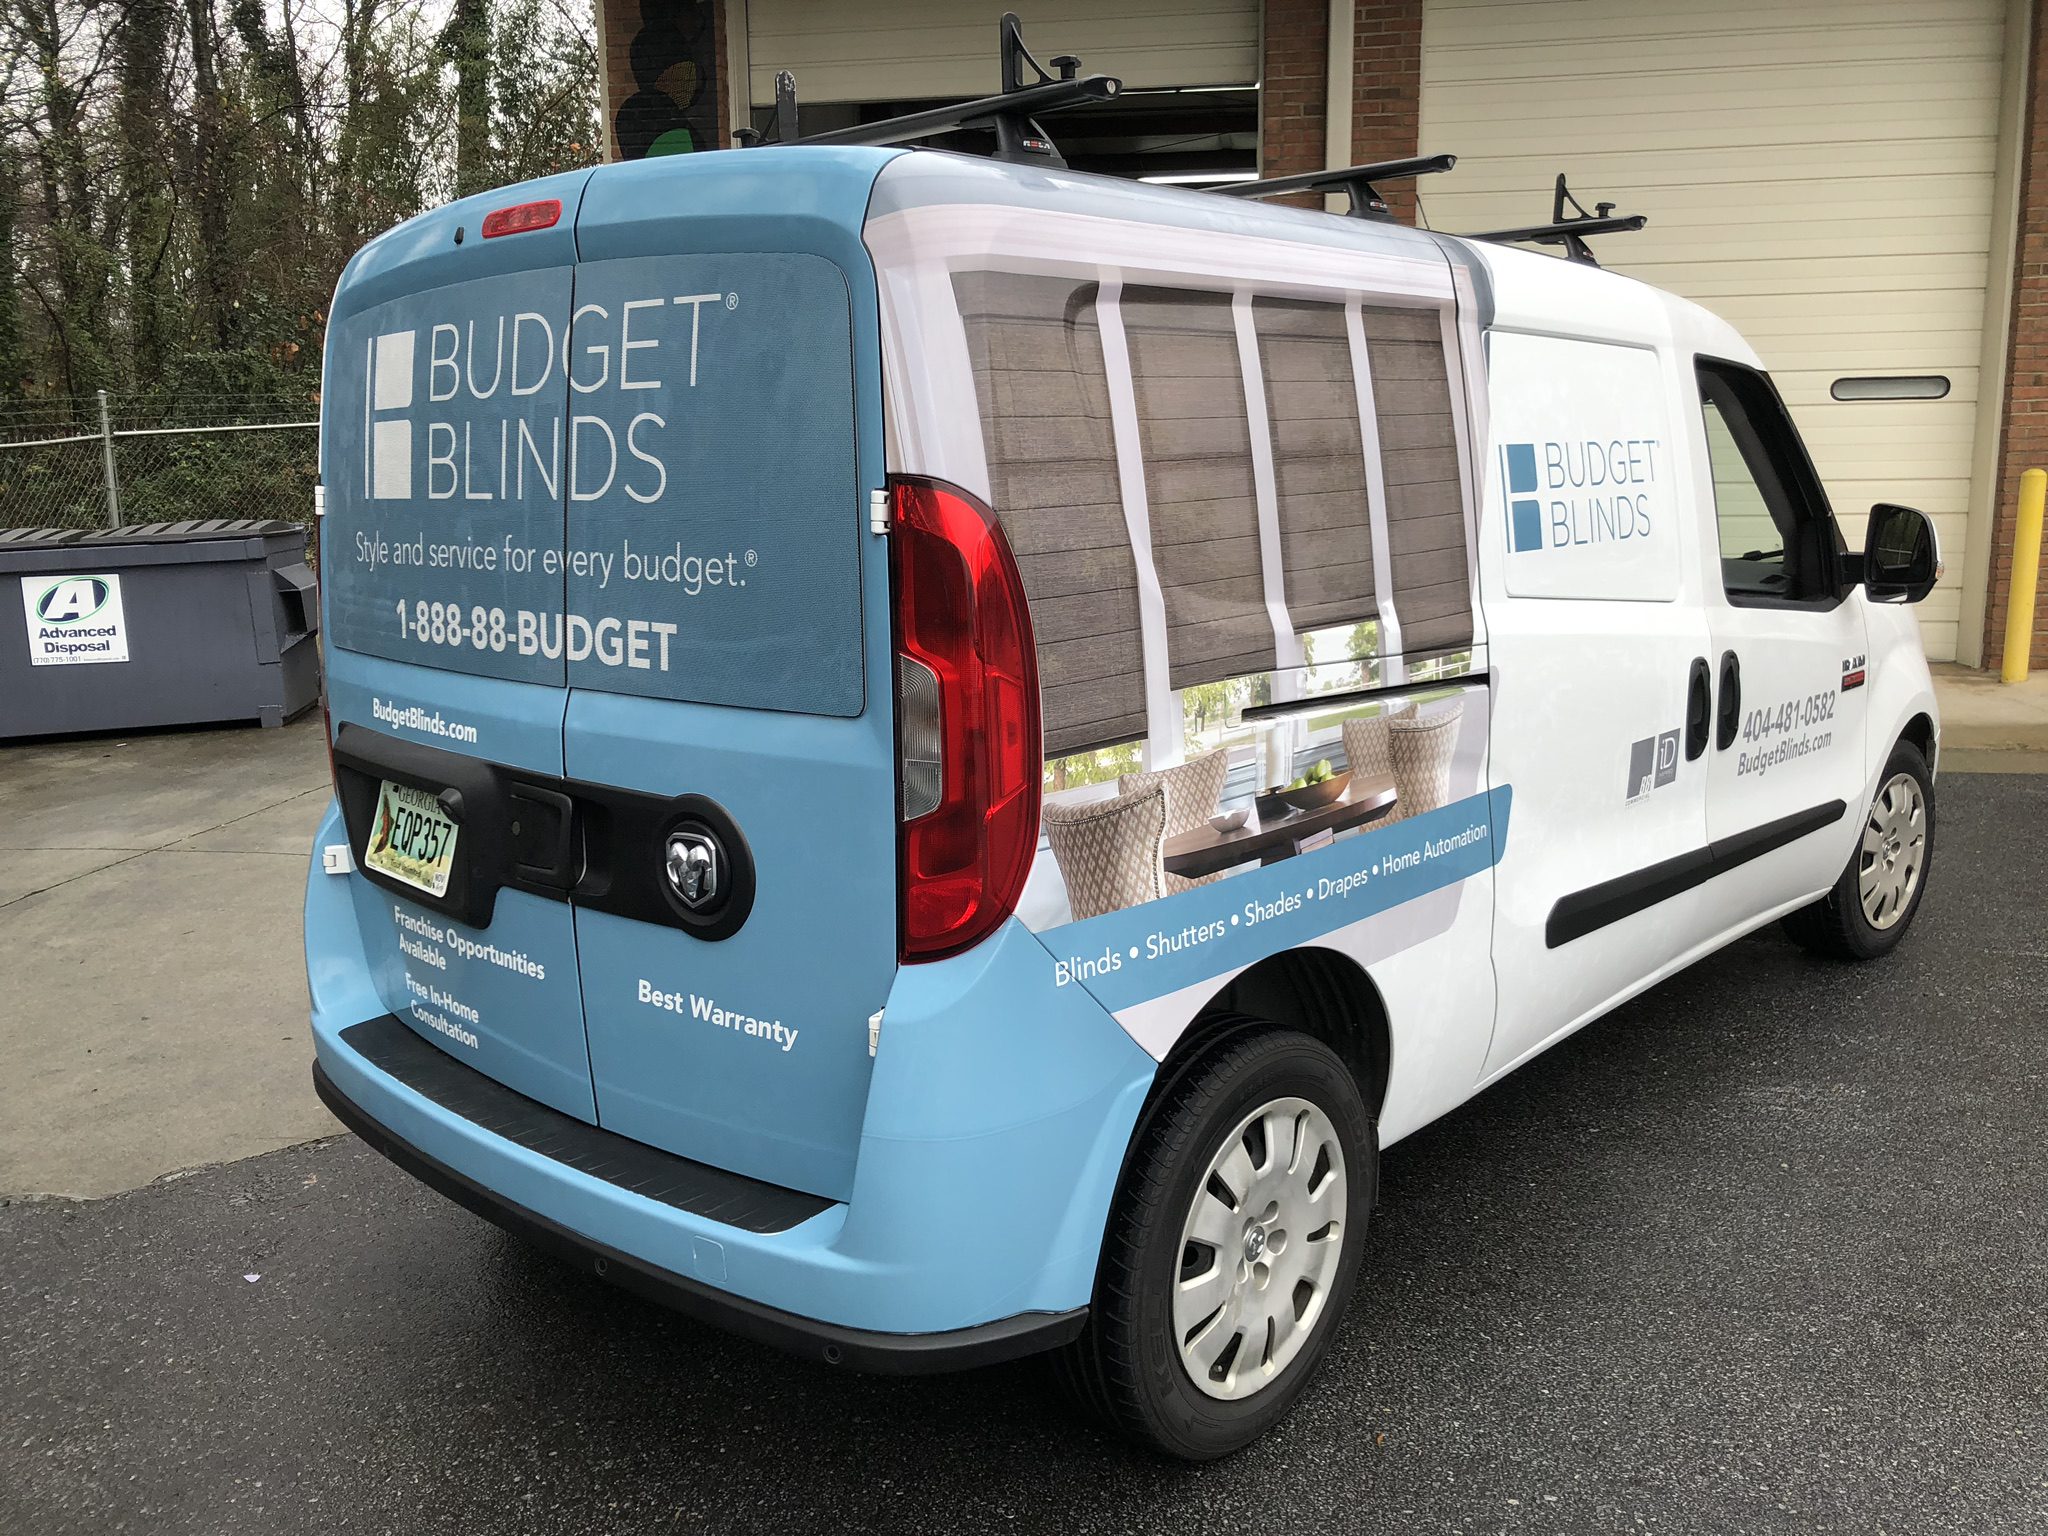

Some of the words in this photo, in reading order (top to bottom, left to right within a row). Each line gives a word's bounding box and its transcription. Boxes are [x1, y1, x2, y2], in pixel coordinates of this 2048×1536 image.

[428, 412, 667, 504] BLINDS
[1551, 493, 1651, 548] BLINDS
[356, 531, 388, 572] Style
[393, 532, 424, 567] and
[429, 537, 497, 571] service
[503, 534, 537, 573] for
[543, 548, 614, 589] every
[39, 625, 117, 639] Advanced
[44, 640, 111, 655] Disposal
[396, 598, 678, 671] 1-888-88-BUDGET
[373, 697, 478, 744] BudgetBlinds.com
[1743, 690, 1836, 743] 404-481-0582
[1737, 732, 1832, 776] BudgetBlinds.com
[398, 785, 441, 815] GEORGIA
[390, 807, 451, 868] EQP357
[1055, 947, 1122, 988] Blinds
[1146, 917, 1226, 960] Shutters
[1244, 890, 1302, 927] Shades
[1318, 870, 1368, 901] Drapes
[1383, 852, 1420, 877] Home
[1423, 822, 1488, 860] Automation
[394, 905, 444, 943] Franchise
[446, 928, 545, 980] Opportunities
[399, 933, 447, 970] Available
[405, 972, 428, 999] Free
[430, 985, 479, 1023] In-Home
[410, 999, 479, 1049] Consultation
[638, 979, 684, 1014] Best
[689, 994, 799, 1052] Warranty
